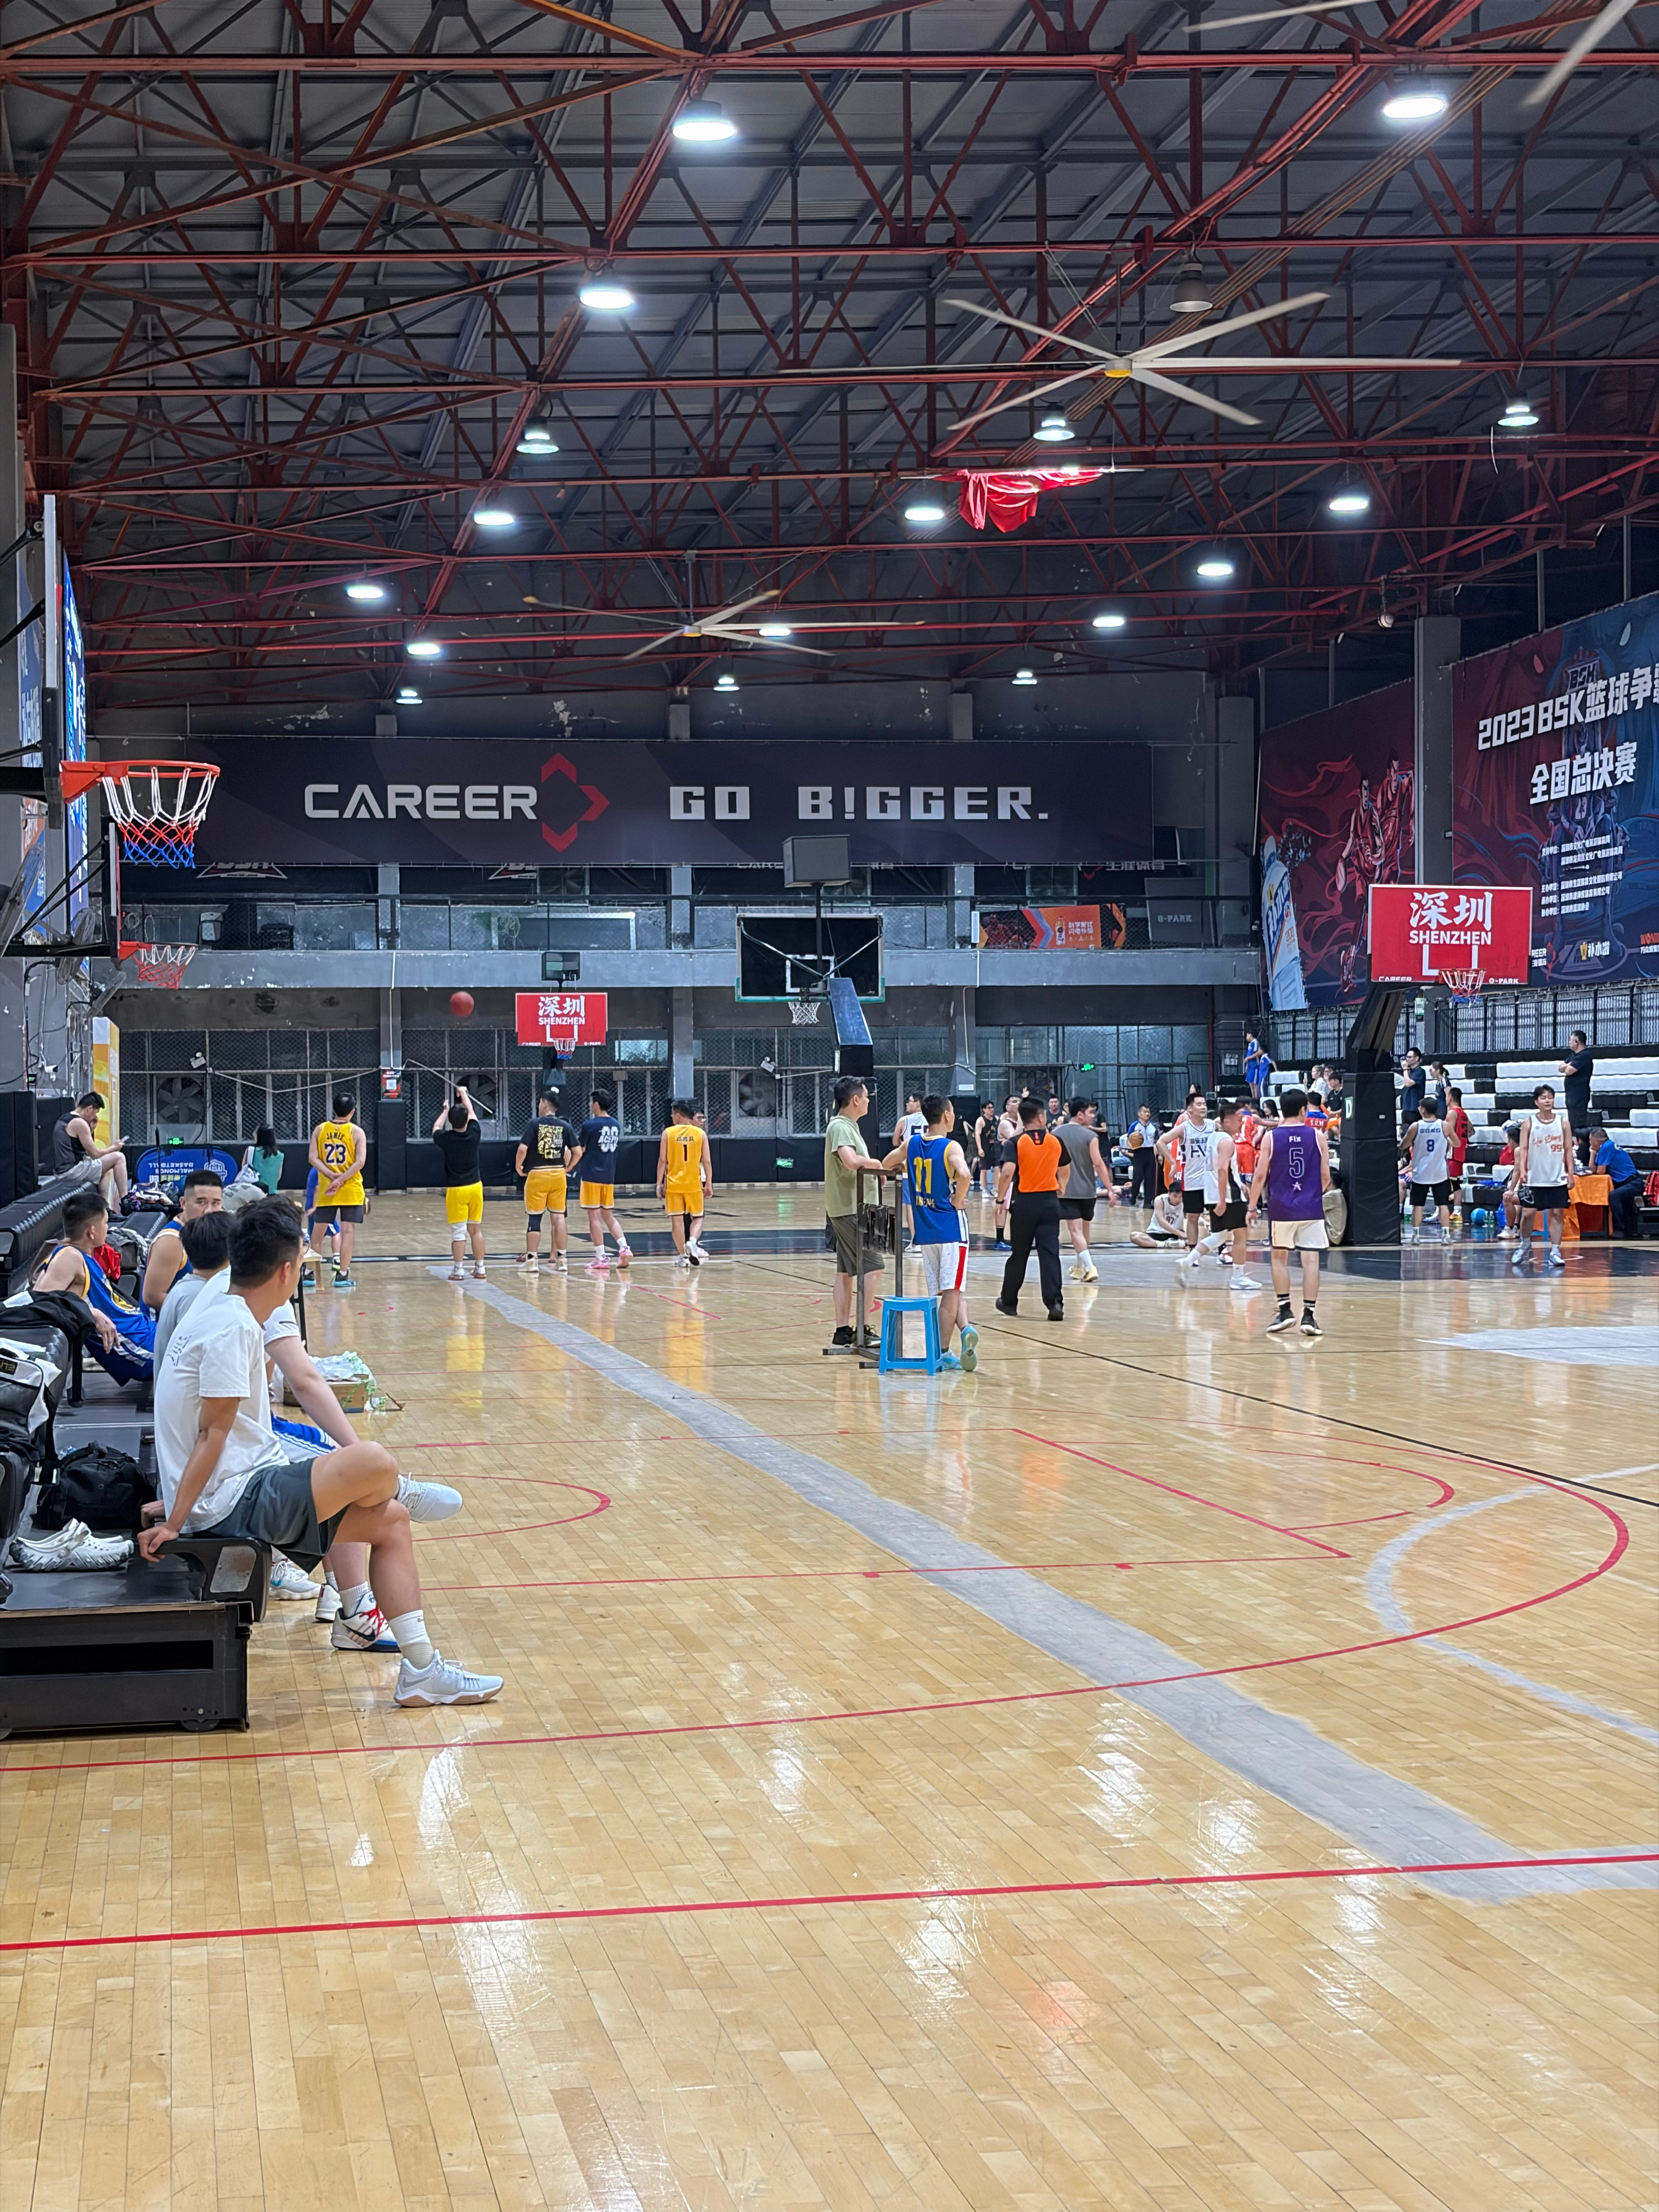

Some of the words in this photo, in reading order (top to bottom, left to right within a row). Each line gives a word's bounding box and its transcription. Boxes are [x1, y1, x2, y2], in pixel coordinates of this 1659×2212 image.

[1530, 742, 1637, 804] 全国总决赛
[305, 784, 537, 819] CAREER
[670, 786, 750, 820] GO
[798, 786, 1048, 820] B!GGER.
[1409, 891, 1493, 931] 深圳
[1409, 930, 1491, 945] SHENZHEN
[538, 995, 585, 1017] 深圳
[538, 1017, 585, 1025] SHENZHEN
[1345, 1099, 1352, 1119] D
[324, 1143, 347, 1164] 23
[683, 1144, 687, 1162] 1
[1426, 1139, 1435, 1153] 8
[1550, 1144, 1562, 1152] 99
[1289, 1147, 1305, 1178] 5
[913, 1156, 932, 1194] 11
